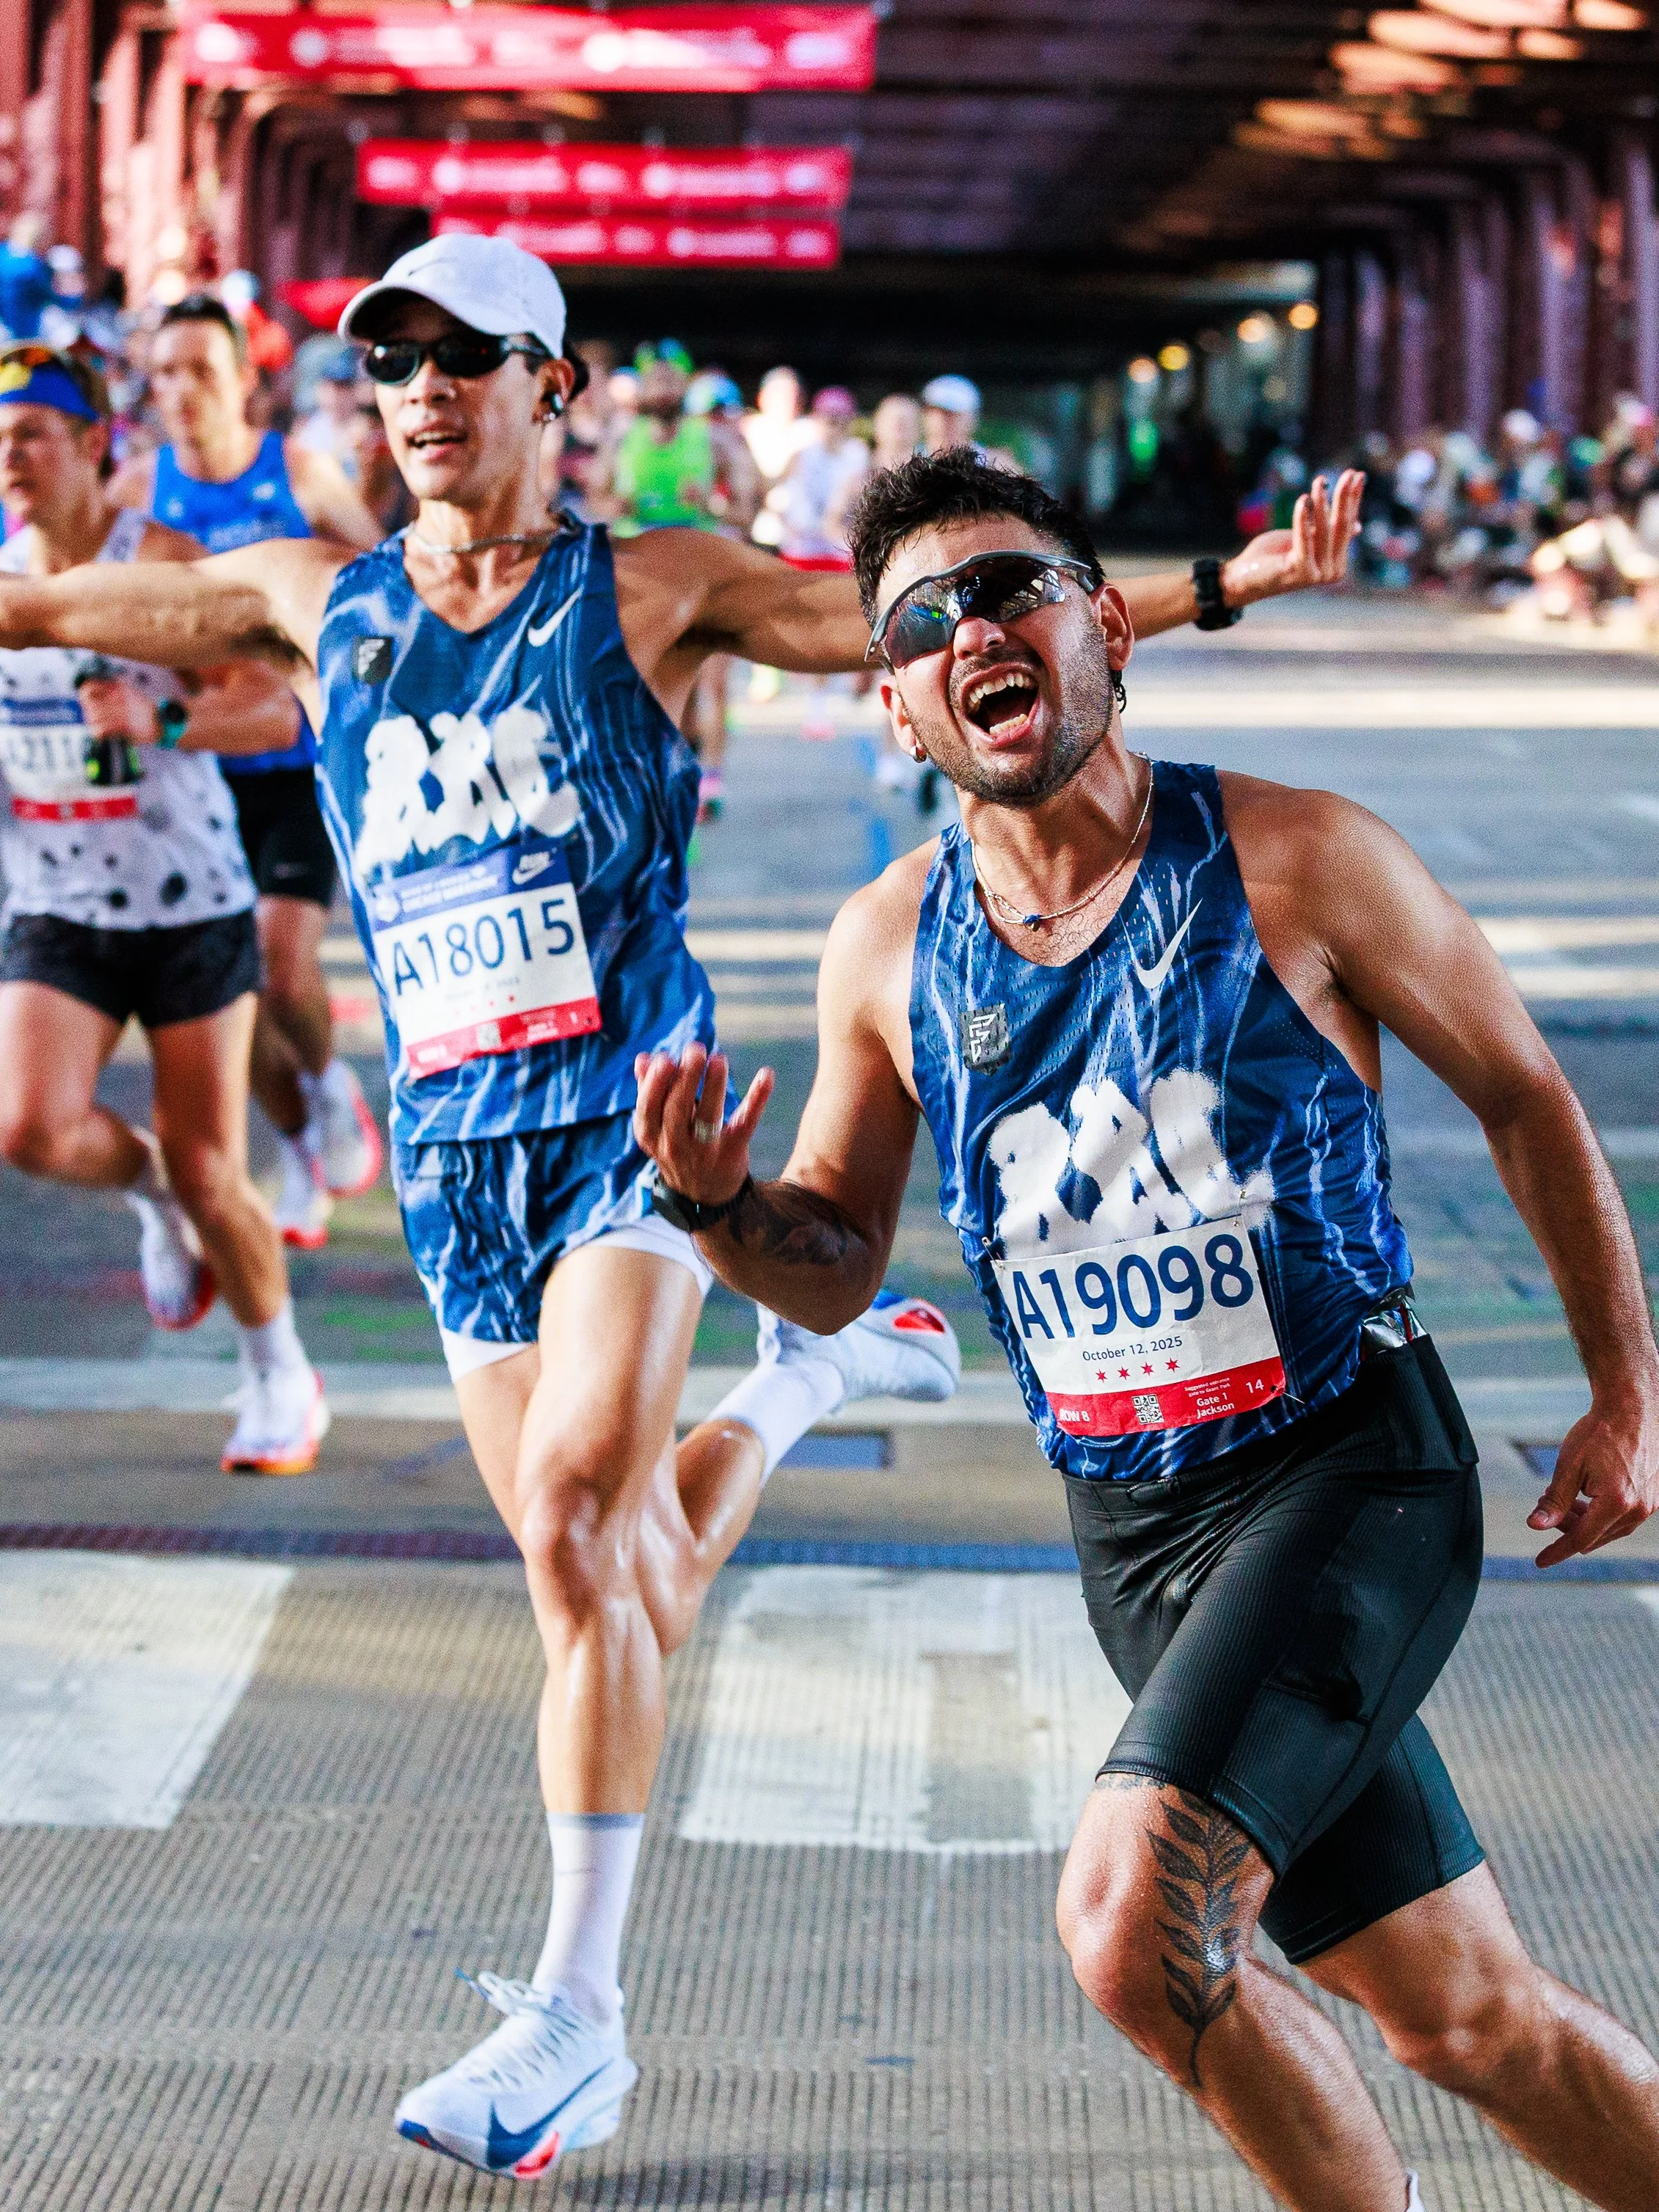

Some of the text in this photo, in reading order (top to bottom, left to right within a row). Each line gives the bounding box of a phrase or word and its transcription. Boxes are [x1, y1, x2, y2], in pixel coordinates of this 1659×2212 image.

[393, 898, 575, 996] A18015
[1012, 1233, 1255, 1340] A19098
[1082, 1335, 1184, 1362] October 12, 2025
[1245, 1379, 1265, 1394] 14
[1196, 1392, 1228, 1406] Gate 1
[1082, 1409, 1091, 1422] 8
[1196, 1402, 1236, 1420] Jackson
